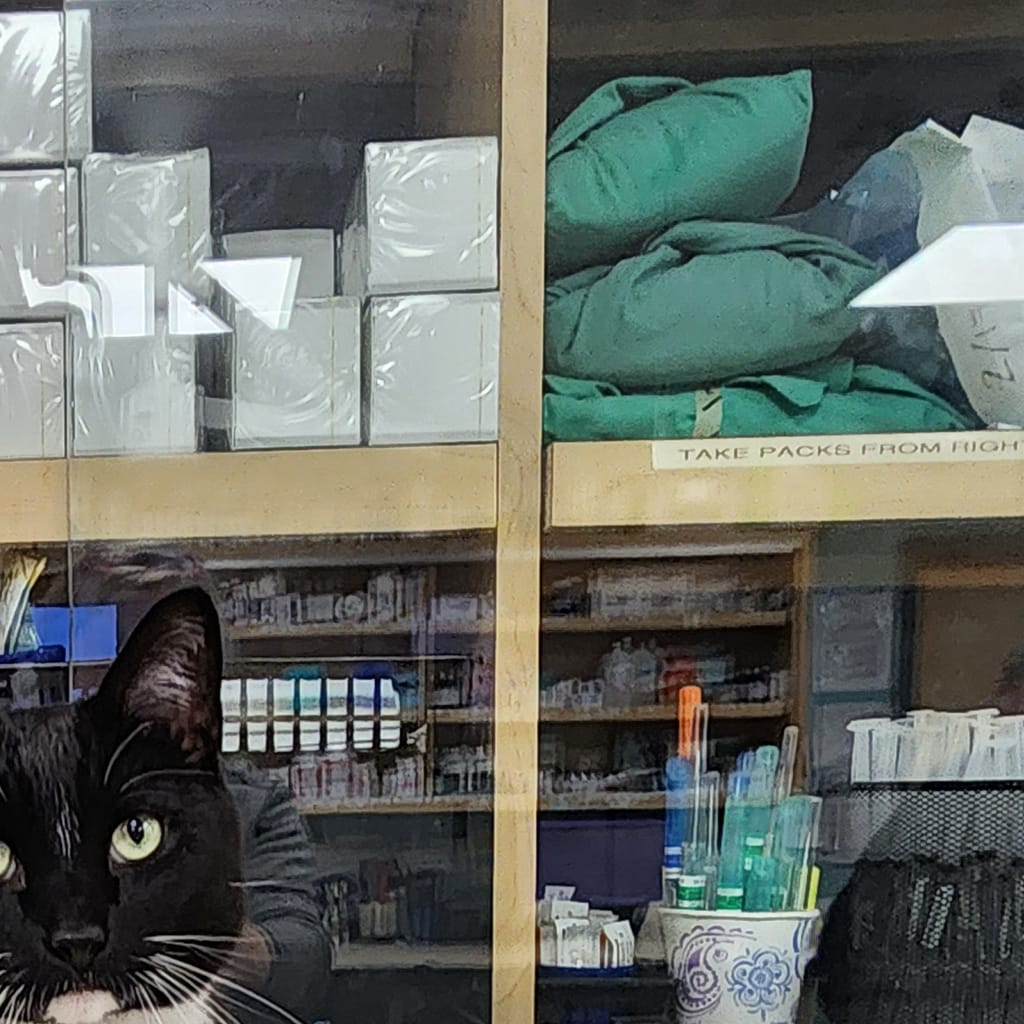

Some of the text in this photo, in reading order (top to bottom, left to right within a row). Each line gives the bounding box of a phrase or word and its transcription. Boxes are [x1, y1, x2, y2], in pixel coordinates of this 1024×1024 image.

[678, 447, 750, 461] TAKE
[759, 444, 851, 458] PACKS
[861, 442, 941, 456] FROM
